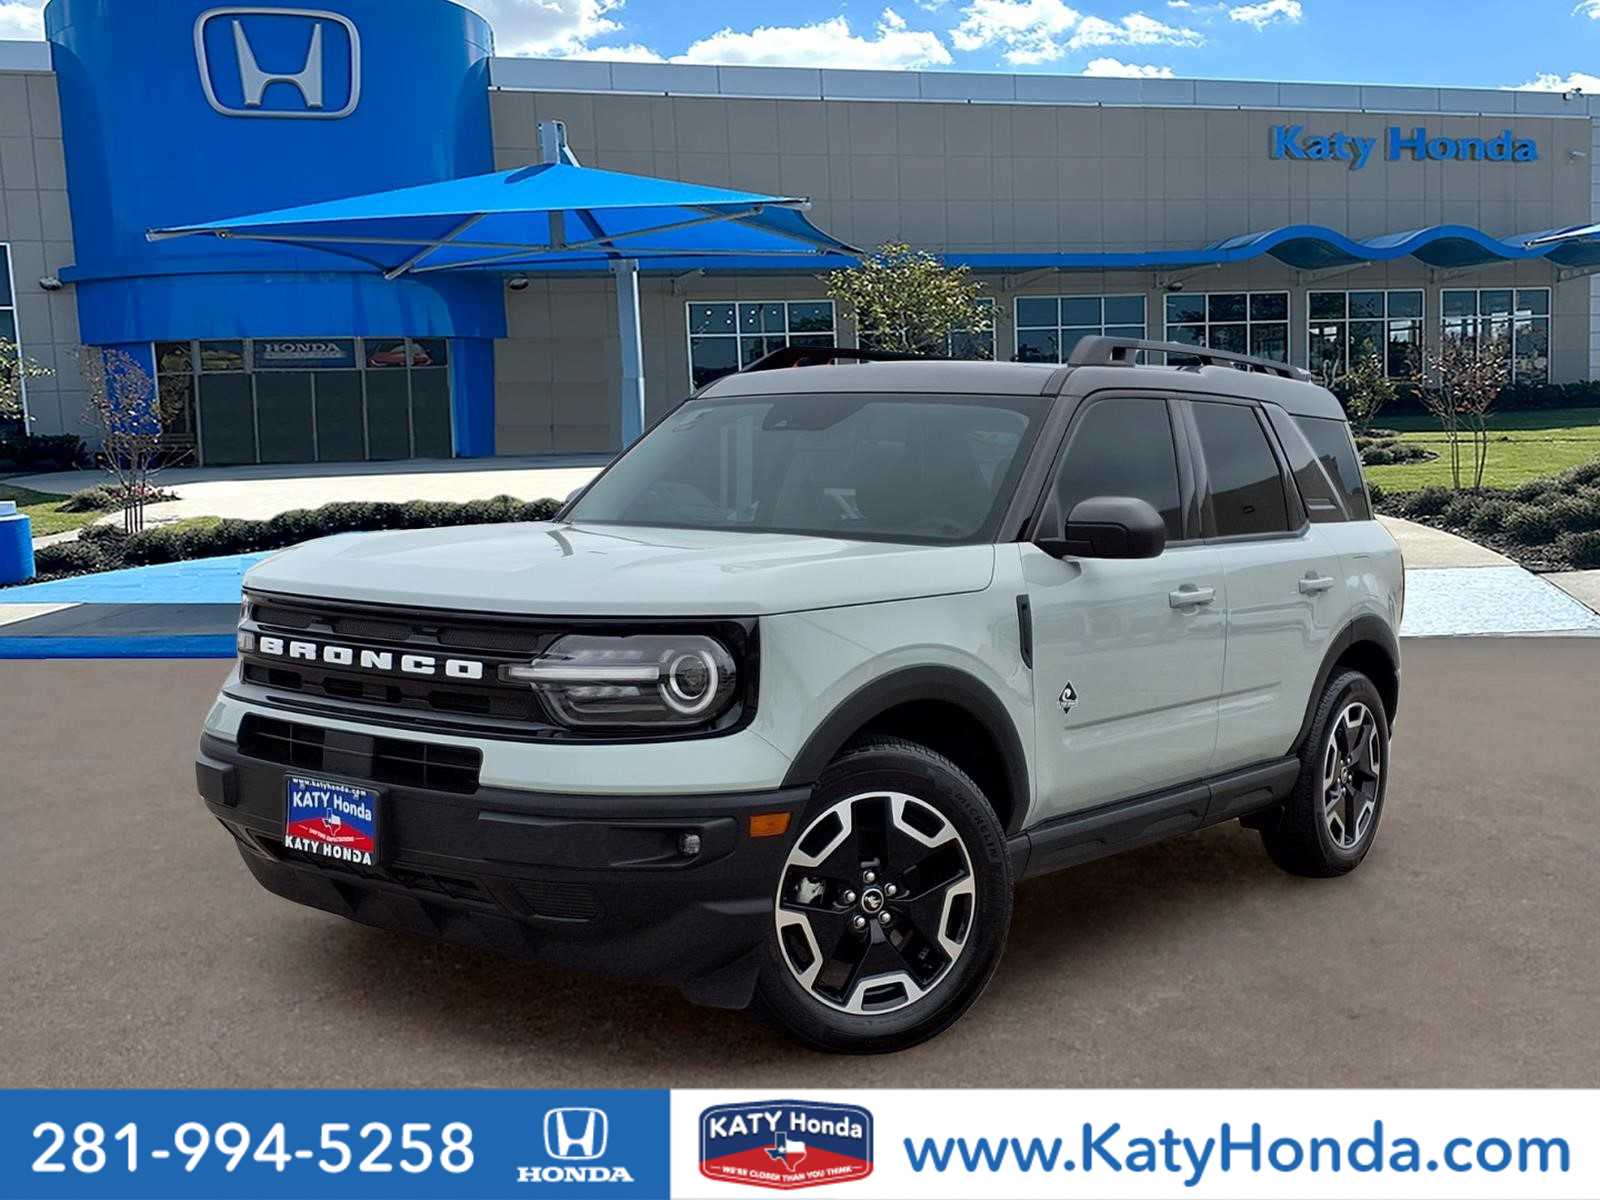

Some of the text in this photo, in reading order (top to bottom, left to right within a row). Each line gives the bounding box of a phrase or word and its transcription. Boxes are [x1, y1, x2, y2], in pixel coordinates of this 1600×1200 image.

[1269, 125, 1540, 170] Katy Honda
[264, 343, 341, 352] HONDA
[259, 636, 483, 679] BRONCO
[293, 791, 372, 821] KATY Honda
[285, 835, 372, 865] KATY HONDA
